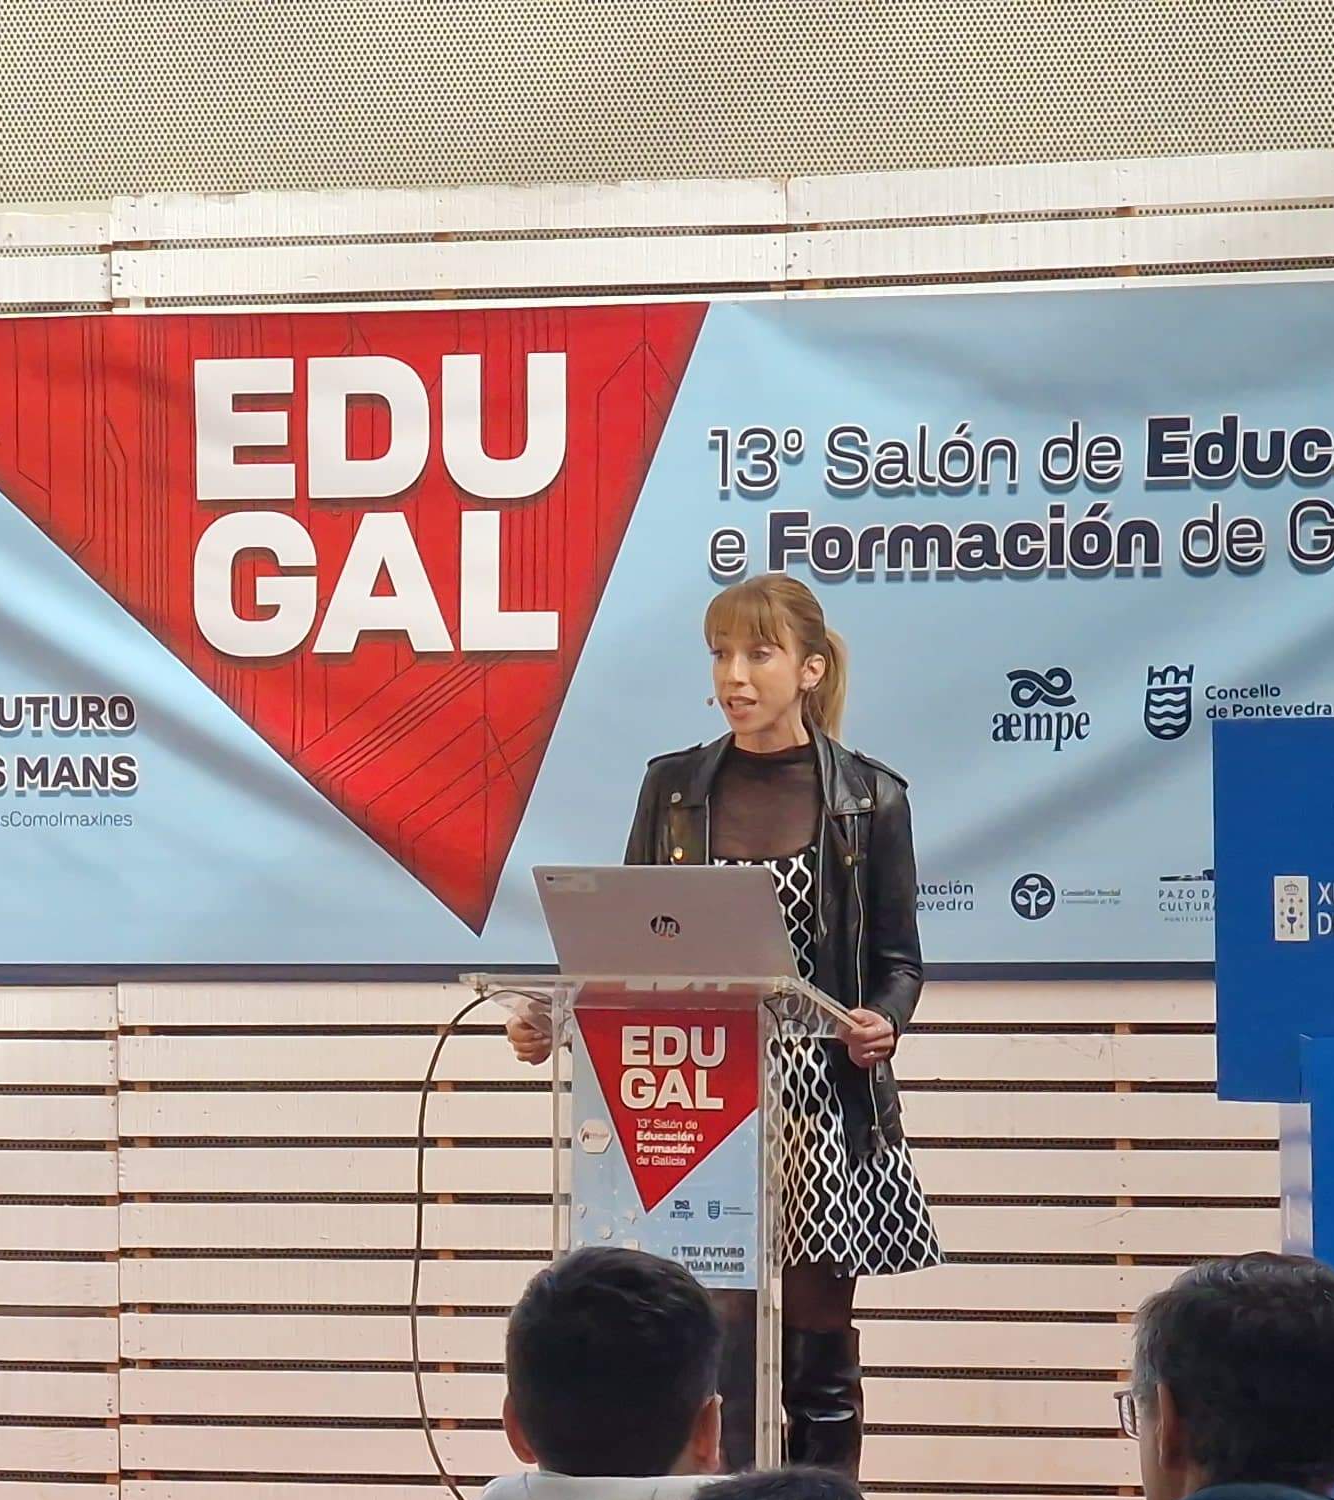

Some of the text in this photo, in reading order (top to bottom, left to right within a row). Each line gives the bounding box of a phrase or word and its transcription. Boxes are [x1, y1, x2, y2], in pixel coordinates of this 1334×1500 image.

[194, 352, 567, 500] EDU
[825, 421, 1019, 489] Salón
[1040, 420, 1124, 485] de
[708, 526, 747, 576] e
[768, 502, 1160, 574] Formación
[1180, 502, 1266, 567] de
[193, 510, 559, 657] GAL
[1205, 684, 1281, 701] Concello
[1206, 701, 1333, 719] de Pontevedra
[16, 755, 138, 791] MANS
[1158, 889, 1195, 899] PAZO
[621, 1026, 726, 1067] EDU
[620, 1069, 724, 1110] GAL
[636, 1142, 695, 1154] Formación
[651, 1156, 686, 1166] Galicia
